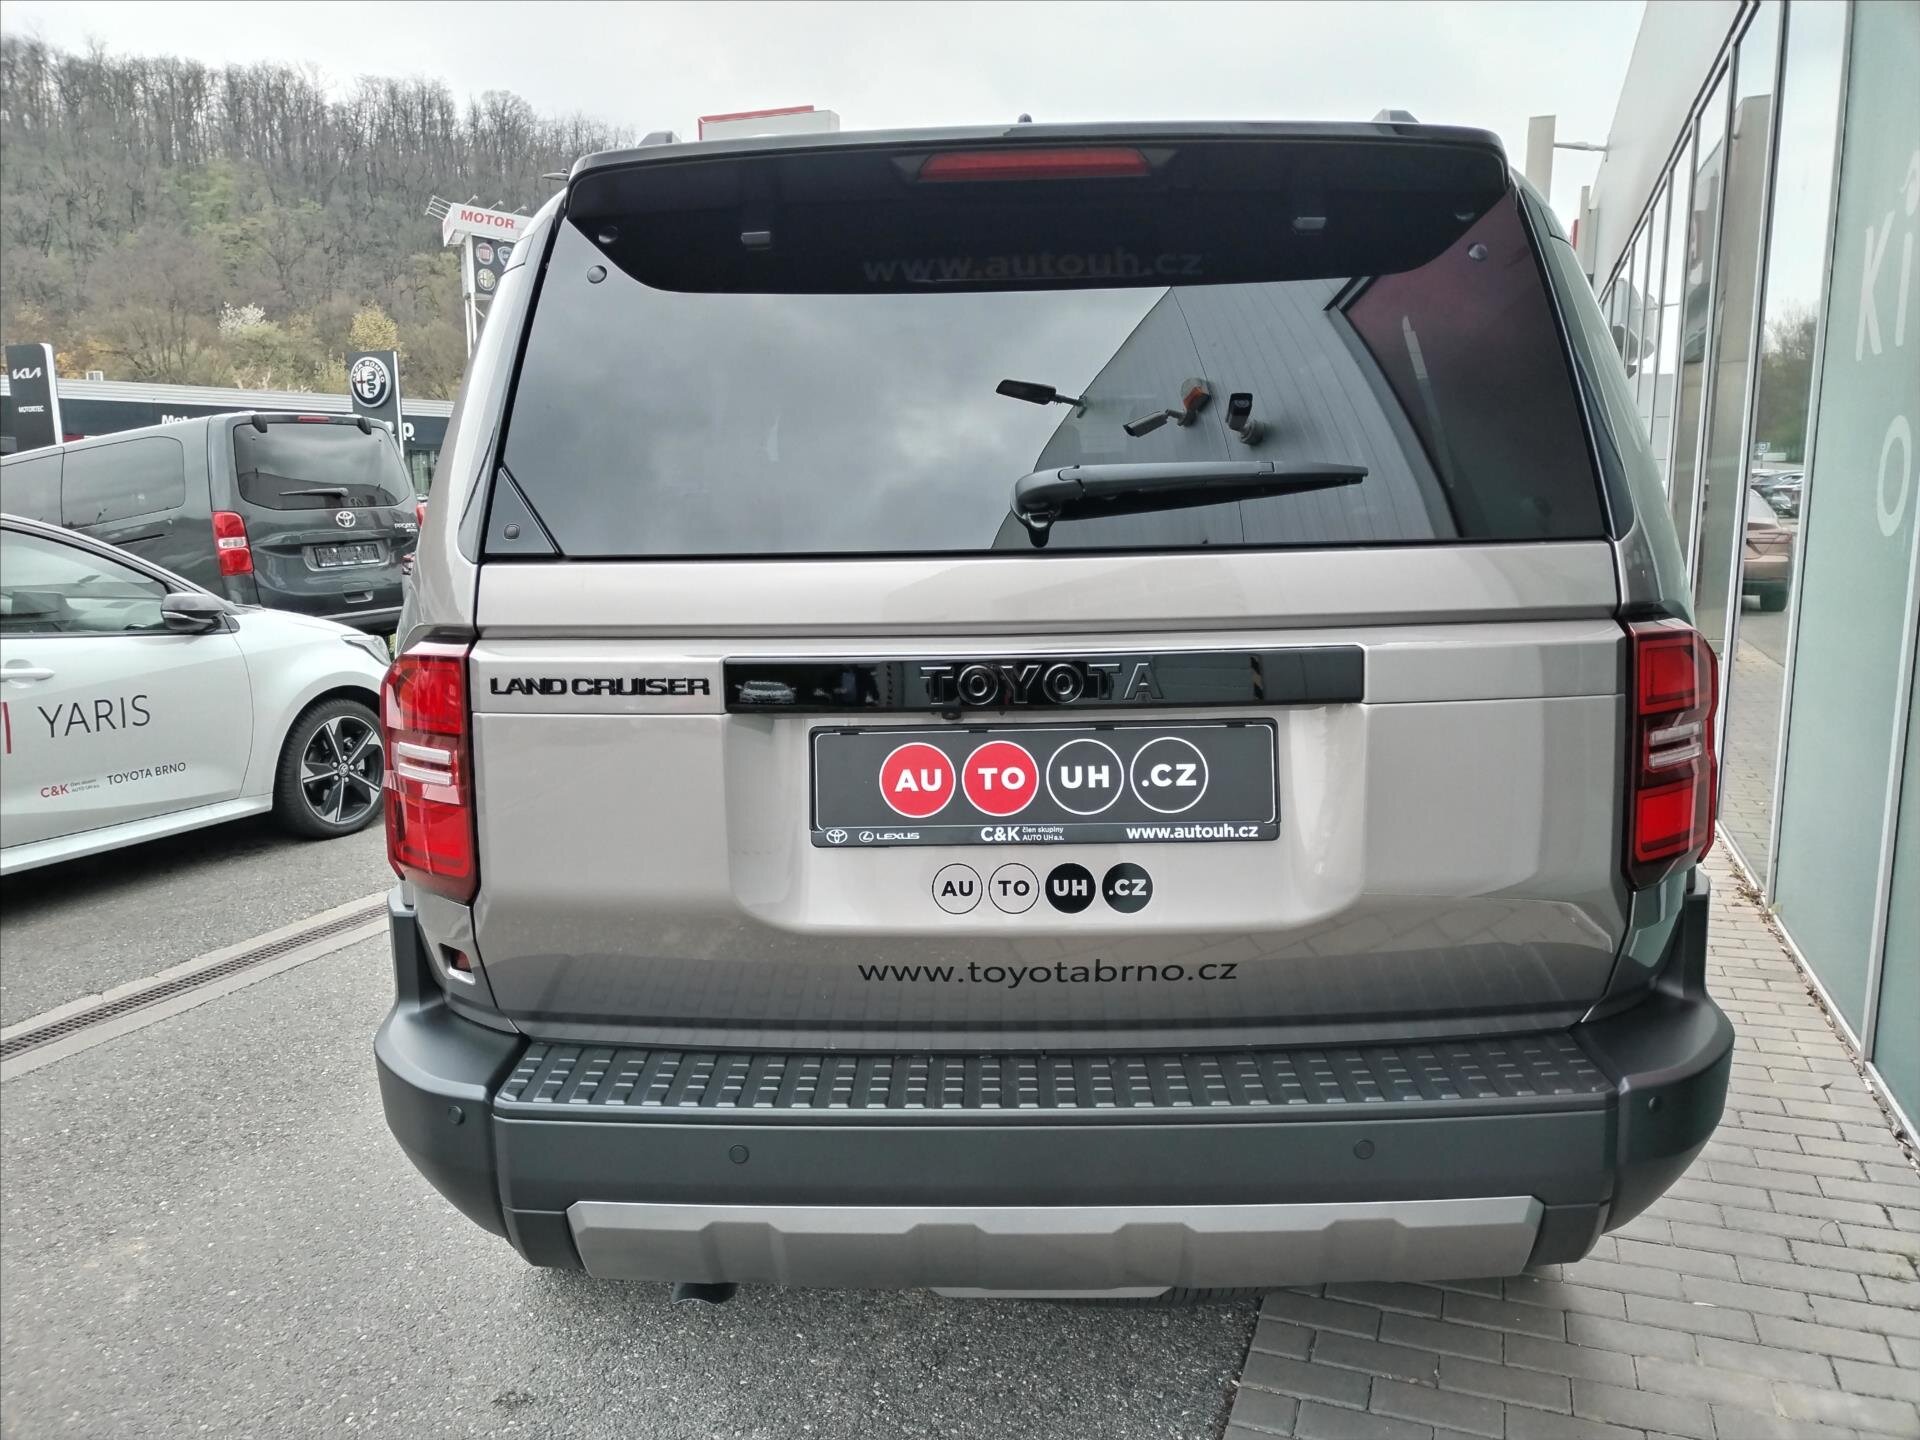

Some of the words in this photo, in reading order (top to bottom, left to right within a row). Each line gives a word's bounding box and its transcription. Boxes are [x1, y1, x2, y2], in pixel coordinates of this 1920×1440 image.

[460, 210, 515, 229] MOTOR
[863, 247, 1204, 283] www.autouh.cz
[490, 677, 567, 696] LAND
[571, 676, 711, 696] CRUISER
[920, 662, 1164, 705] TOYOTA
[37, 694, 151, 738] YARIS
[106, 768, 153, 785] TOYOTA
[154, 762, 187, 777] BRNO
[895, 768, 943, 792] AU
[977, 766, 1026, 791] TO
[1060, 765, 1110, 789] UH
[1141, 763, 1197, 787] .CZ
[40, 783, 70, 799] C&K
[876, 832, 920, 840] LEXUS
[980, 826, 1021, 842] C&K
[1125, 823, 1259, 840] www.autouh.cz
[940, 880, 974, 897] AU
[997, 879, 1030, 896] TO
[1053, 879, 1088, 896] UH
[1107, 878, 1147, 896] .CZ
[857, 959, 1240, 989] www.toyotabrno.cz
